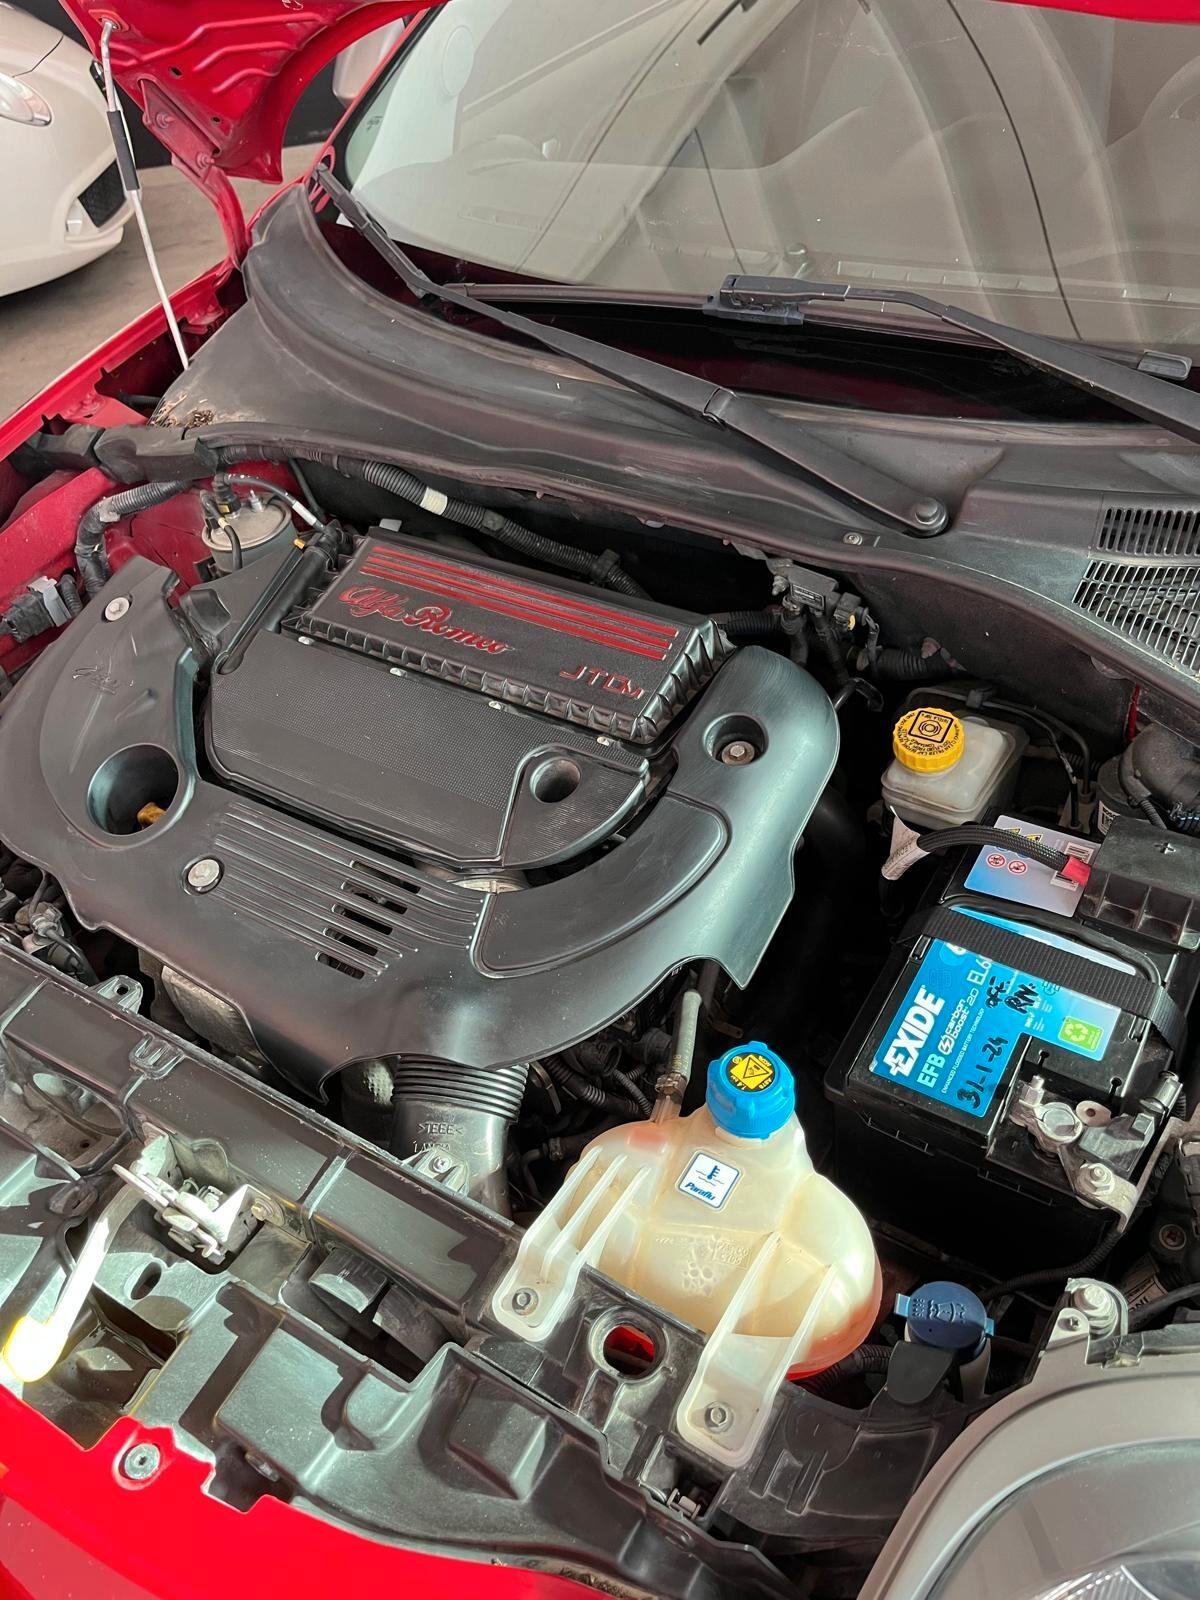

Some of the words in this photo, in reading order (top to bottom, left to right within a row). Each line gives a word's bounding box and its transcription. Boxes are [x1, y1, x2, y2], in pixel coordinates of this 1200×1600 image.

[338, 586, 408, 621] Alfa
[402, 606, 515, 655] Romeo
[883, 987, 945, 1077] EXIDE
[945, 998, 966, 1034] carbon
[951, 1010, 970, 1039] boost
[916, 1053, 946, 1088] EFB
[684, 1182, 716, 1200] Paraflu
